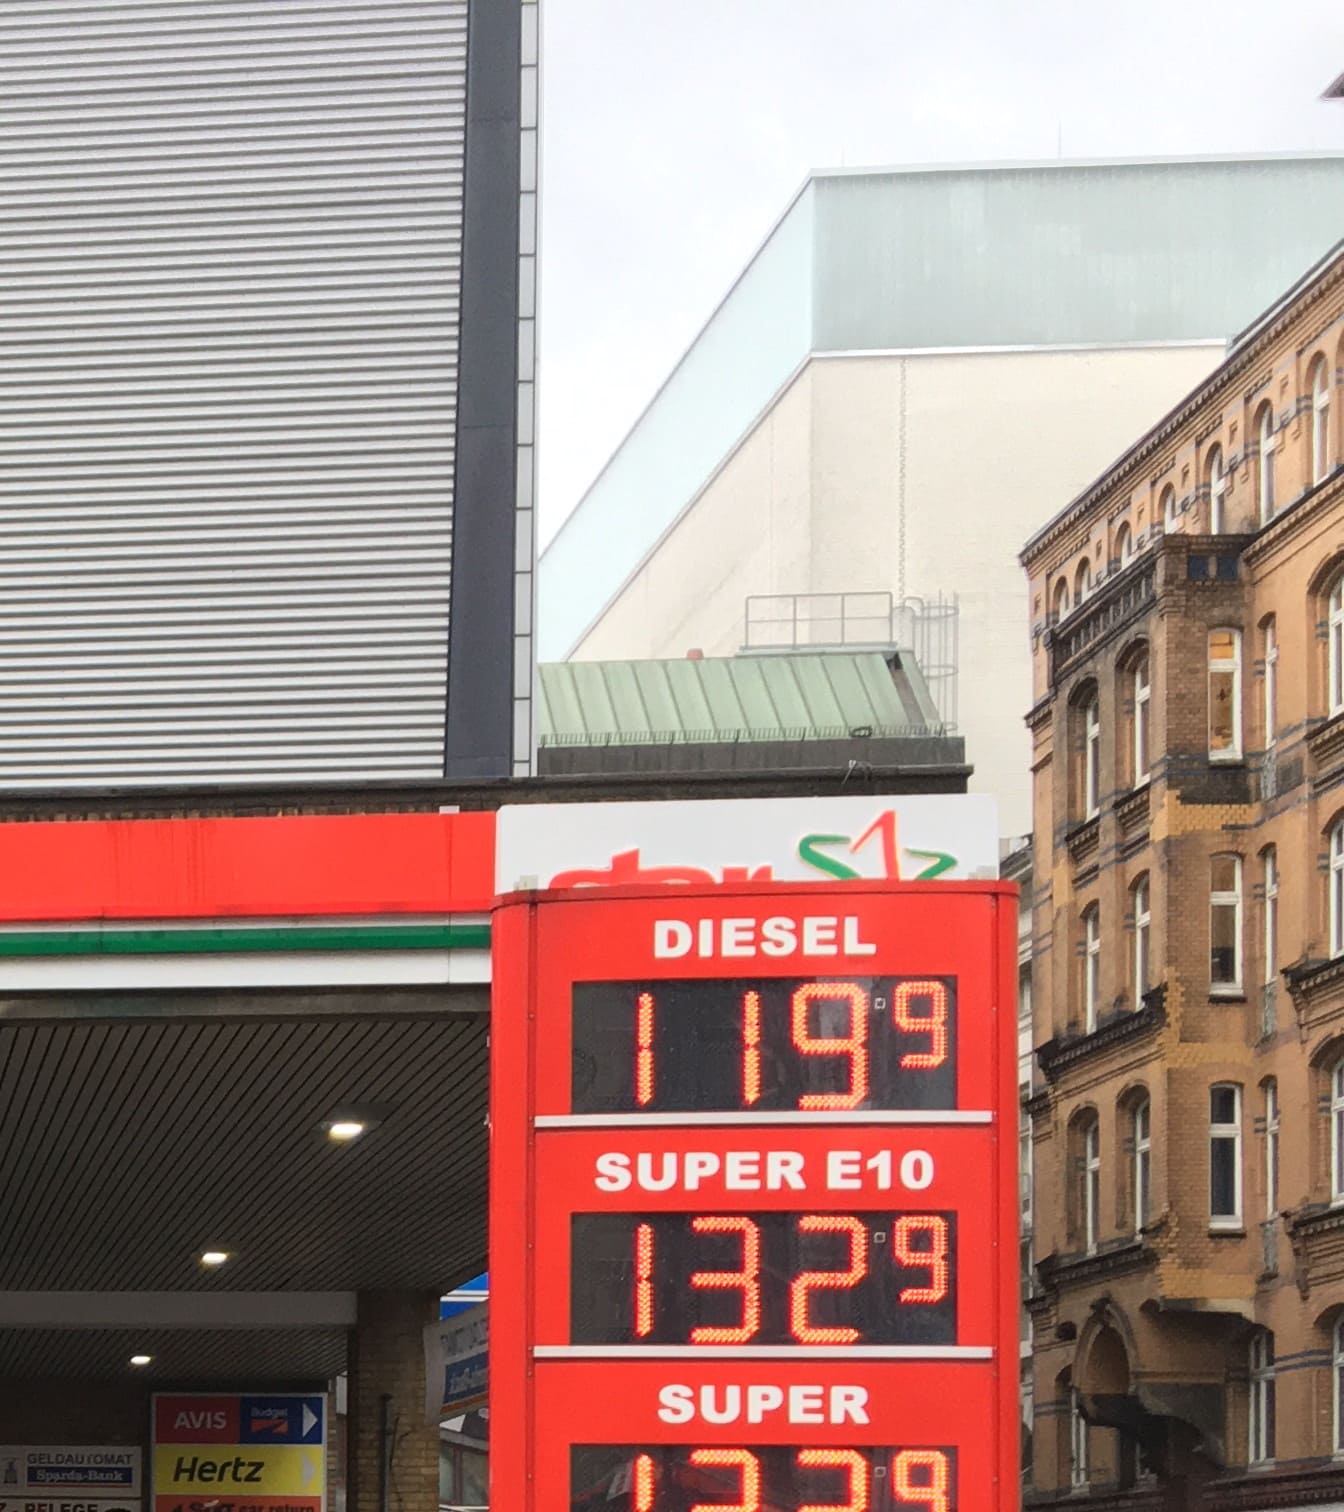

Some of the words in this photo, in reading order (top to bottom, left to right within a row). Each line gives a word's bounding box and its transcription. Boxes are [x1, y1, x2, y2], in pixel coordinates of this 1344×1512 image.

[654, 916, 877, 960] DIESEL
[594, 1151, 806, 1192] SUPER
[826, 1150, 935, 1191] E10
[250, 1407, 289, 1420] Budget
[657, 1383, 871, 1426] SUPER
[173, 1411, 227, 1430] AVIS
[27, 1453, 134, 1465] GELDAUTOMAT
[172, 1457, 265, 1483] Hertz
[36, 1469, 124, 1482] Sparda-Bank
